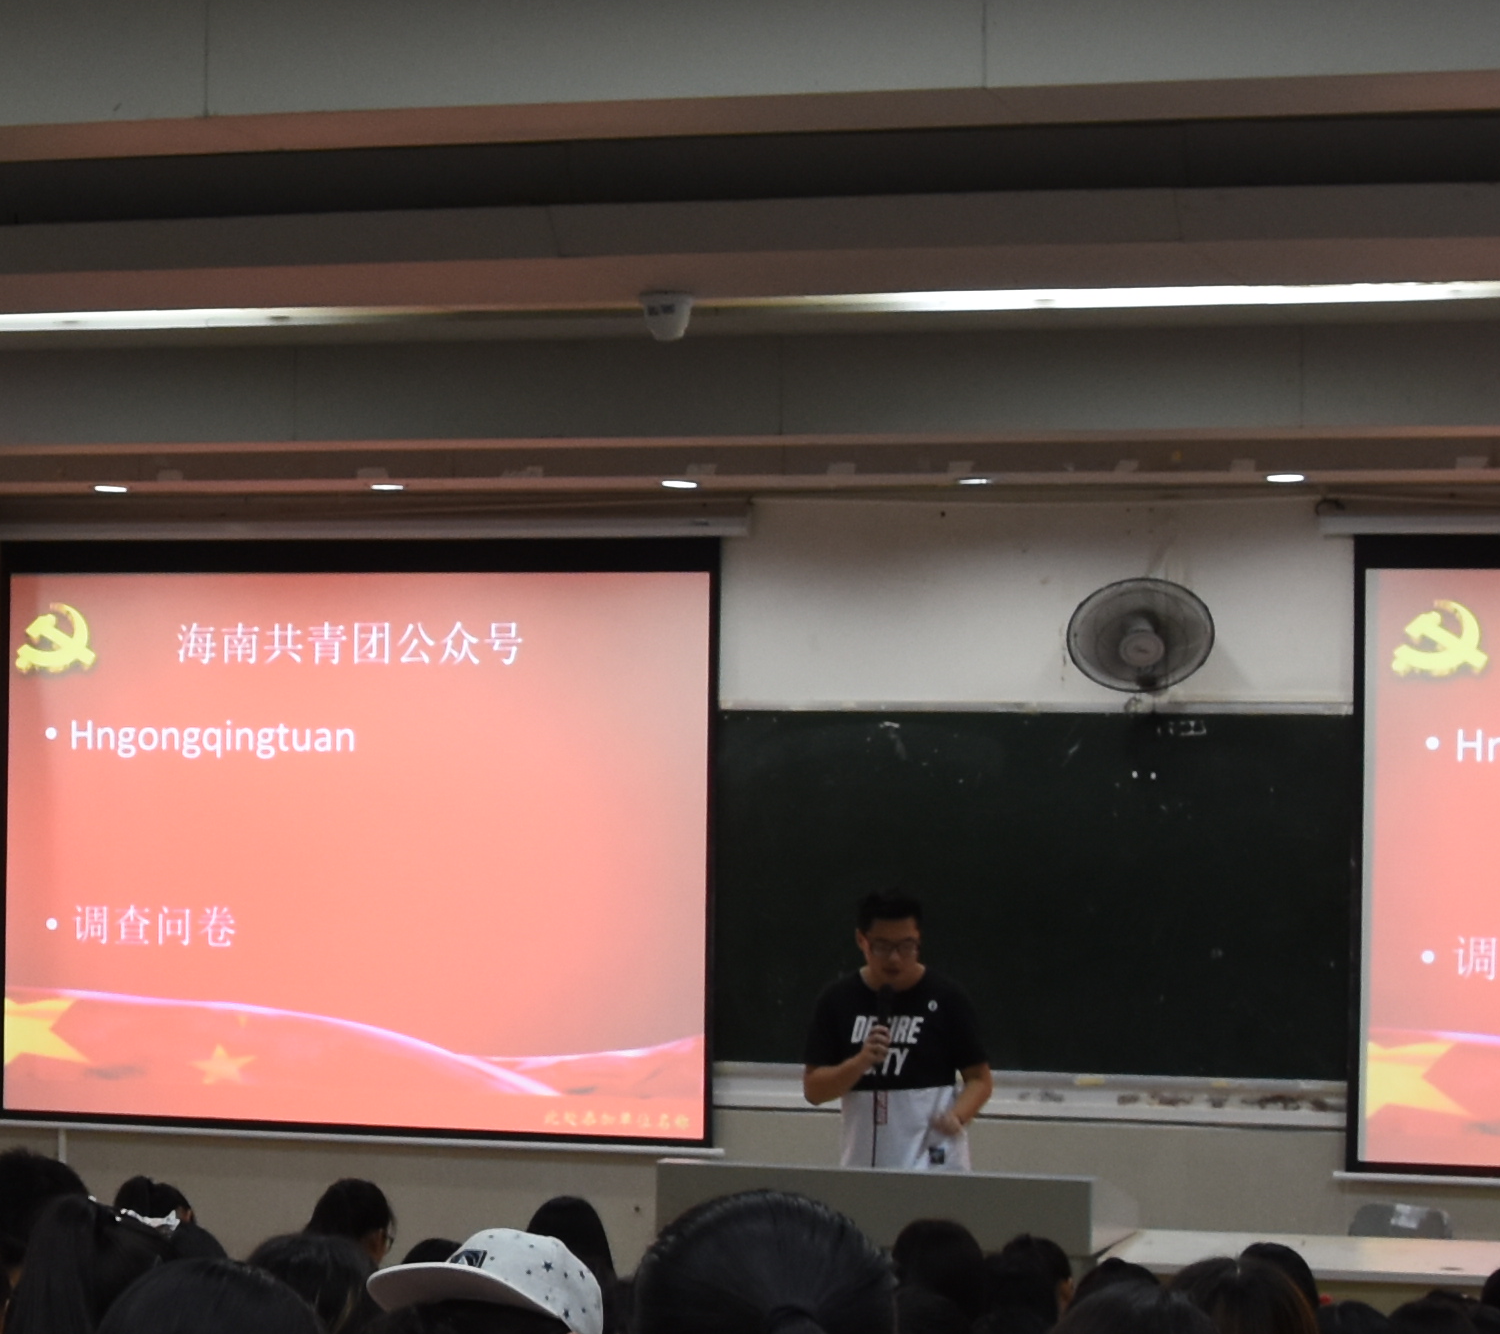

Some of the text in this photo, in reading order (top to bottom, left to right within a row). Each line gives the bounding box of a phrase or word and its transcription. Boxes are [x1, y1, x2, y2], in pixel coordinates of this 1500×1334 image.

[177, 622, 524, 666] 海南共青团公众号
[70, 720, 356, 759] Hngongqingtuan
[74, 904, 236, 948] 调查问卷
